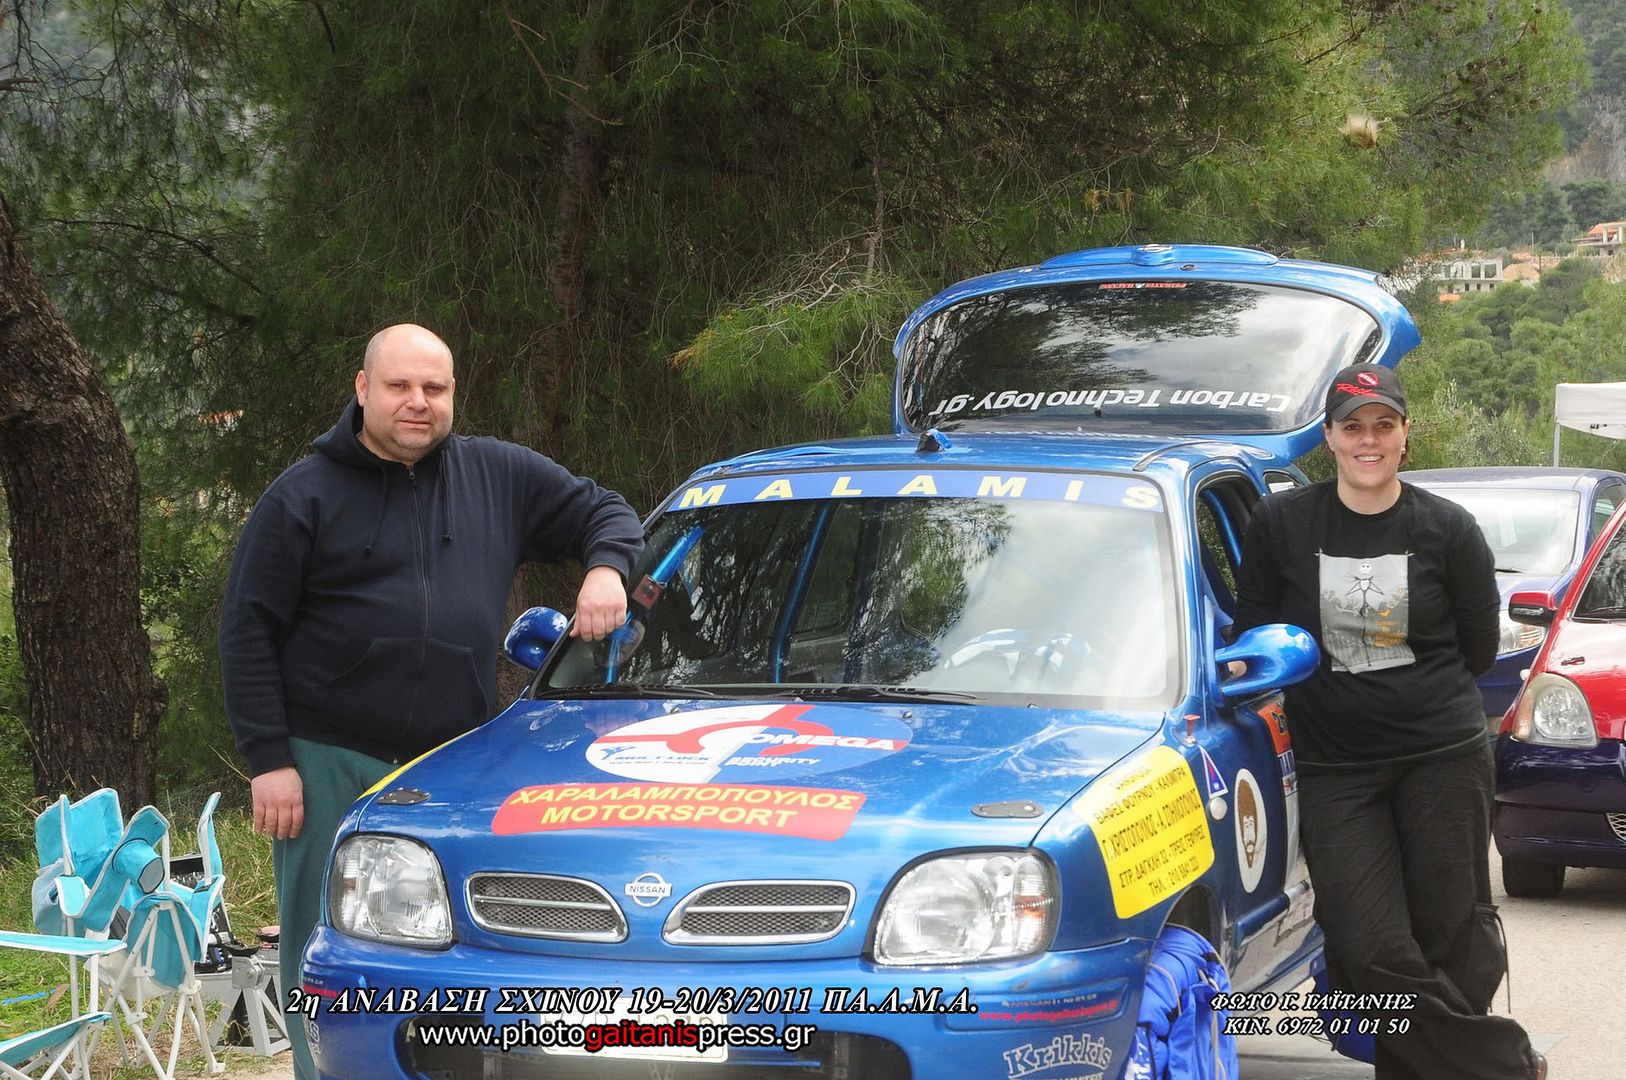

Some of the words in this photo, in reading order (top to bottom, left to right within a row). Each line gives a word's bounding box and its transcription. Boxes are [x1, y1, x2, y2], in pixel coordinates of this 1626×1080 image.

[928, 389, 1160, 416] Technology.gr
[1170, 390, 1291, 413] Carbon
[679, 475, 1160, 508] MALAMIS
[748, 734, 897, 750] OMEGA
[509, 788, 863, 810] ΧΑΡΑΛΑΜΠΟΠΟΥΛΟΣ
[1125, 786, 1155, 811] ΦΟΥΡΝΟΥ
[540, 805, 798, 827] MOTORSPORT
[629, 885, 666, 894] NISSAN
[1003, 1034, 1113, 1076] Krikkis
